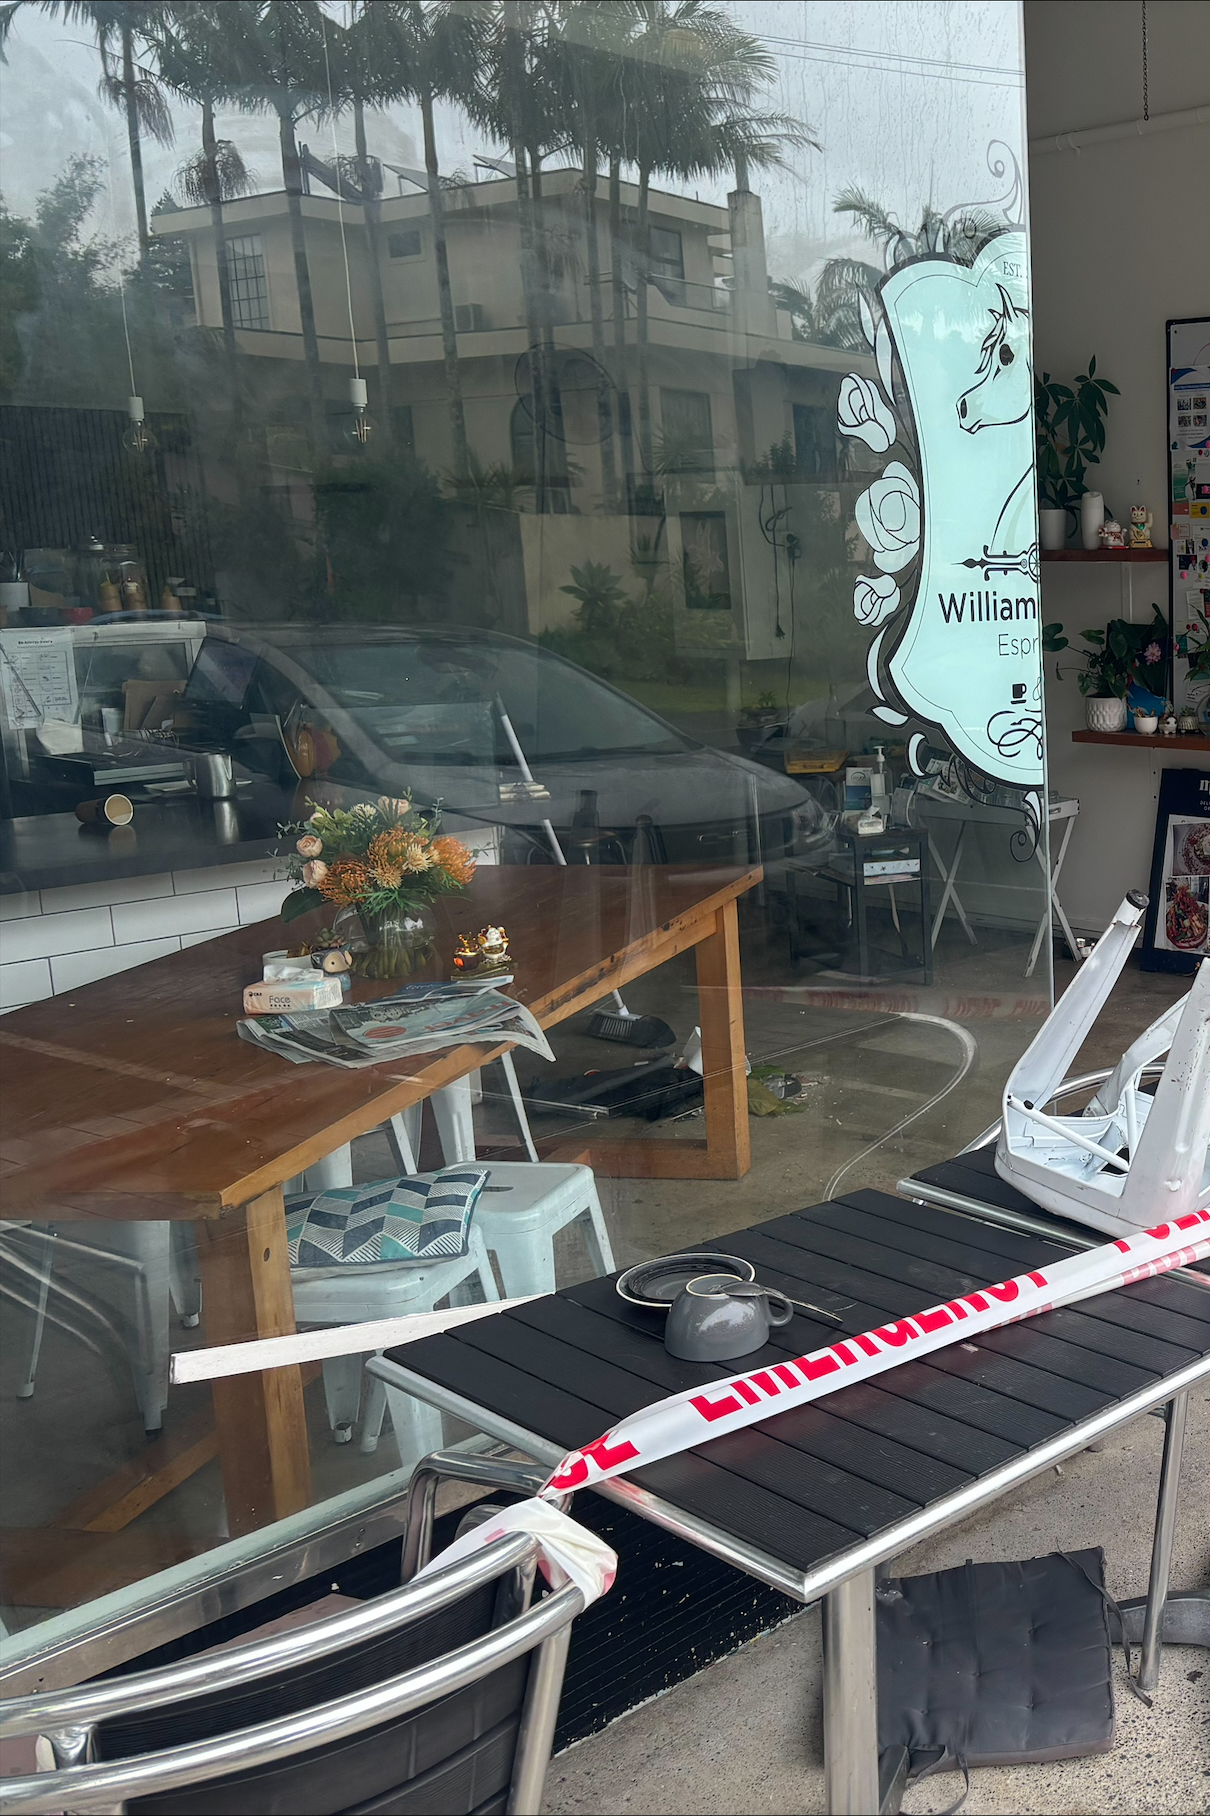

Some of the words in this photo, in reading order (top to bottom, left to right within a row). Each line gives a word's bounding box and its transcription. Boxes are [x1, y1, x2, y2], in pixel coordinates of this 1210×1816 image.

[1003, 261, 1023, 278] EST.
[938, 590, 1036, 623] William
[269, 995, 291, 1004] Face
